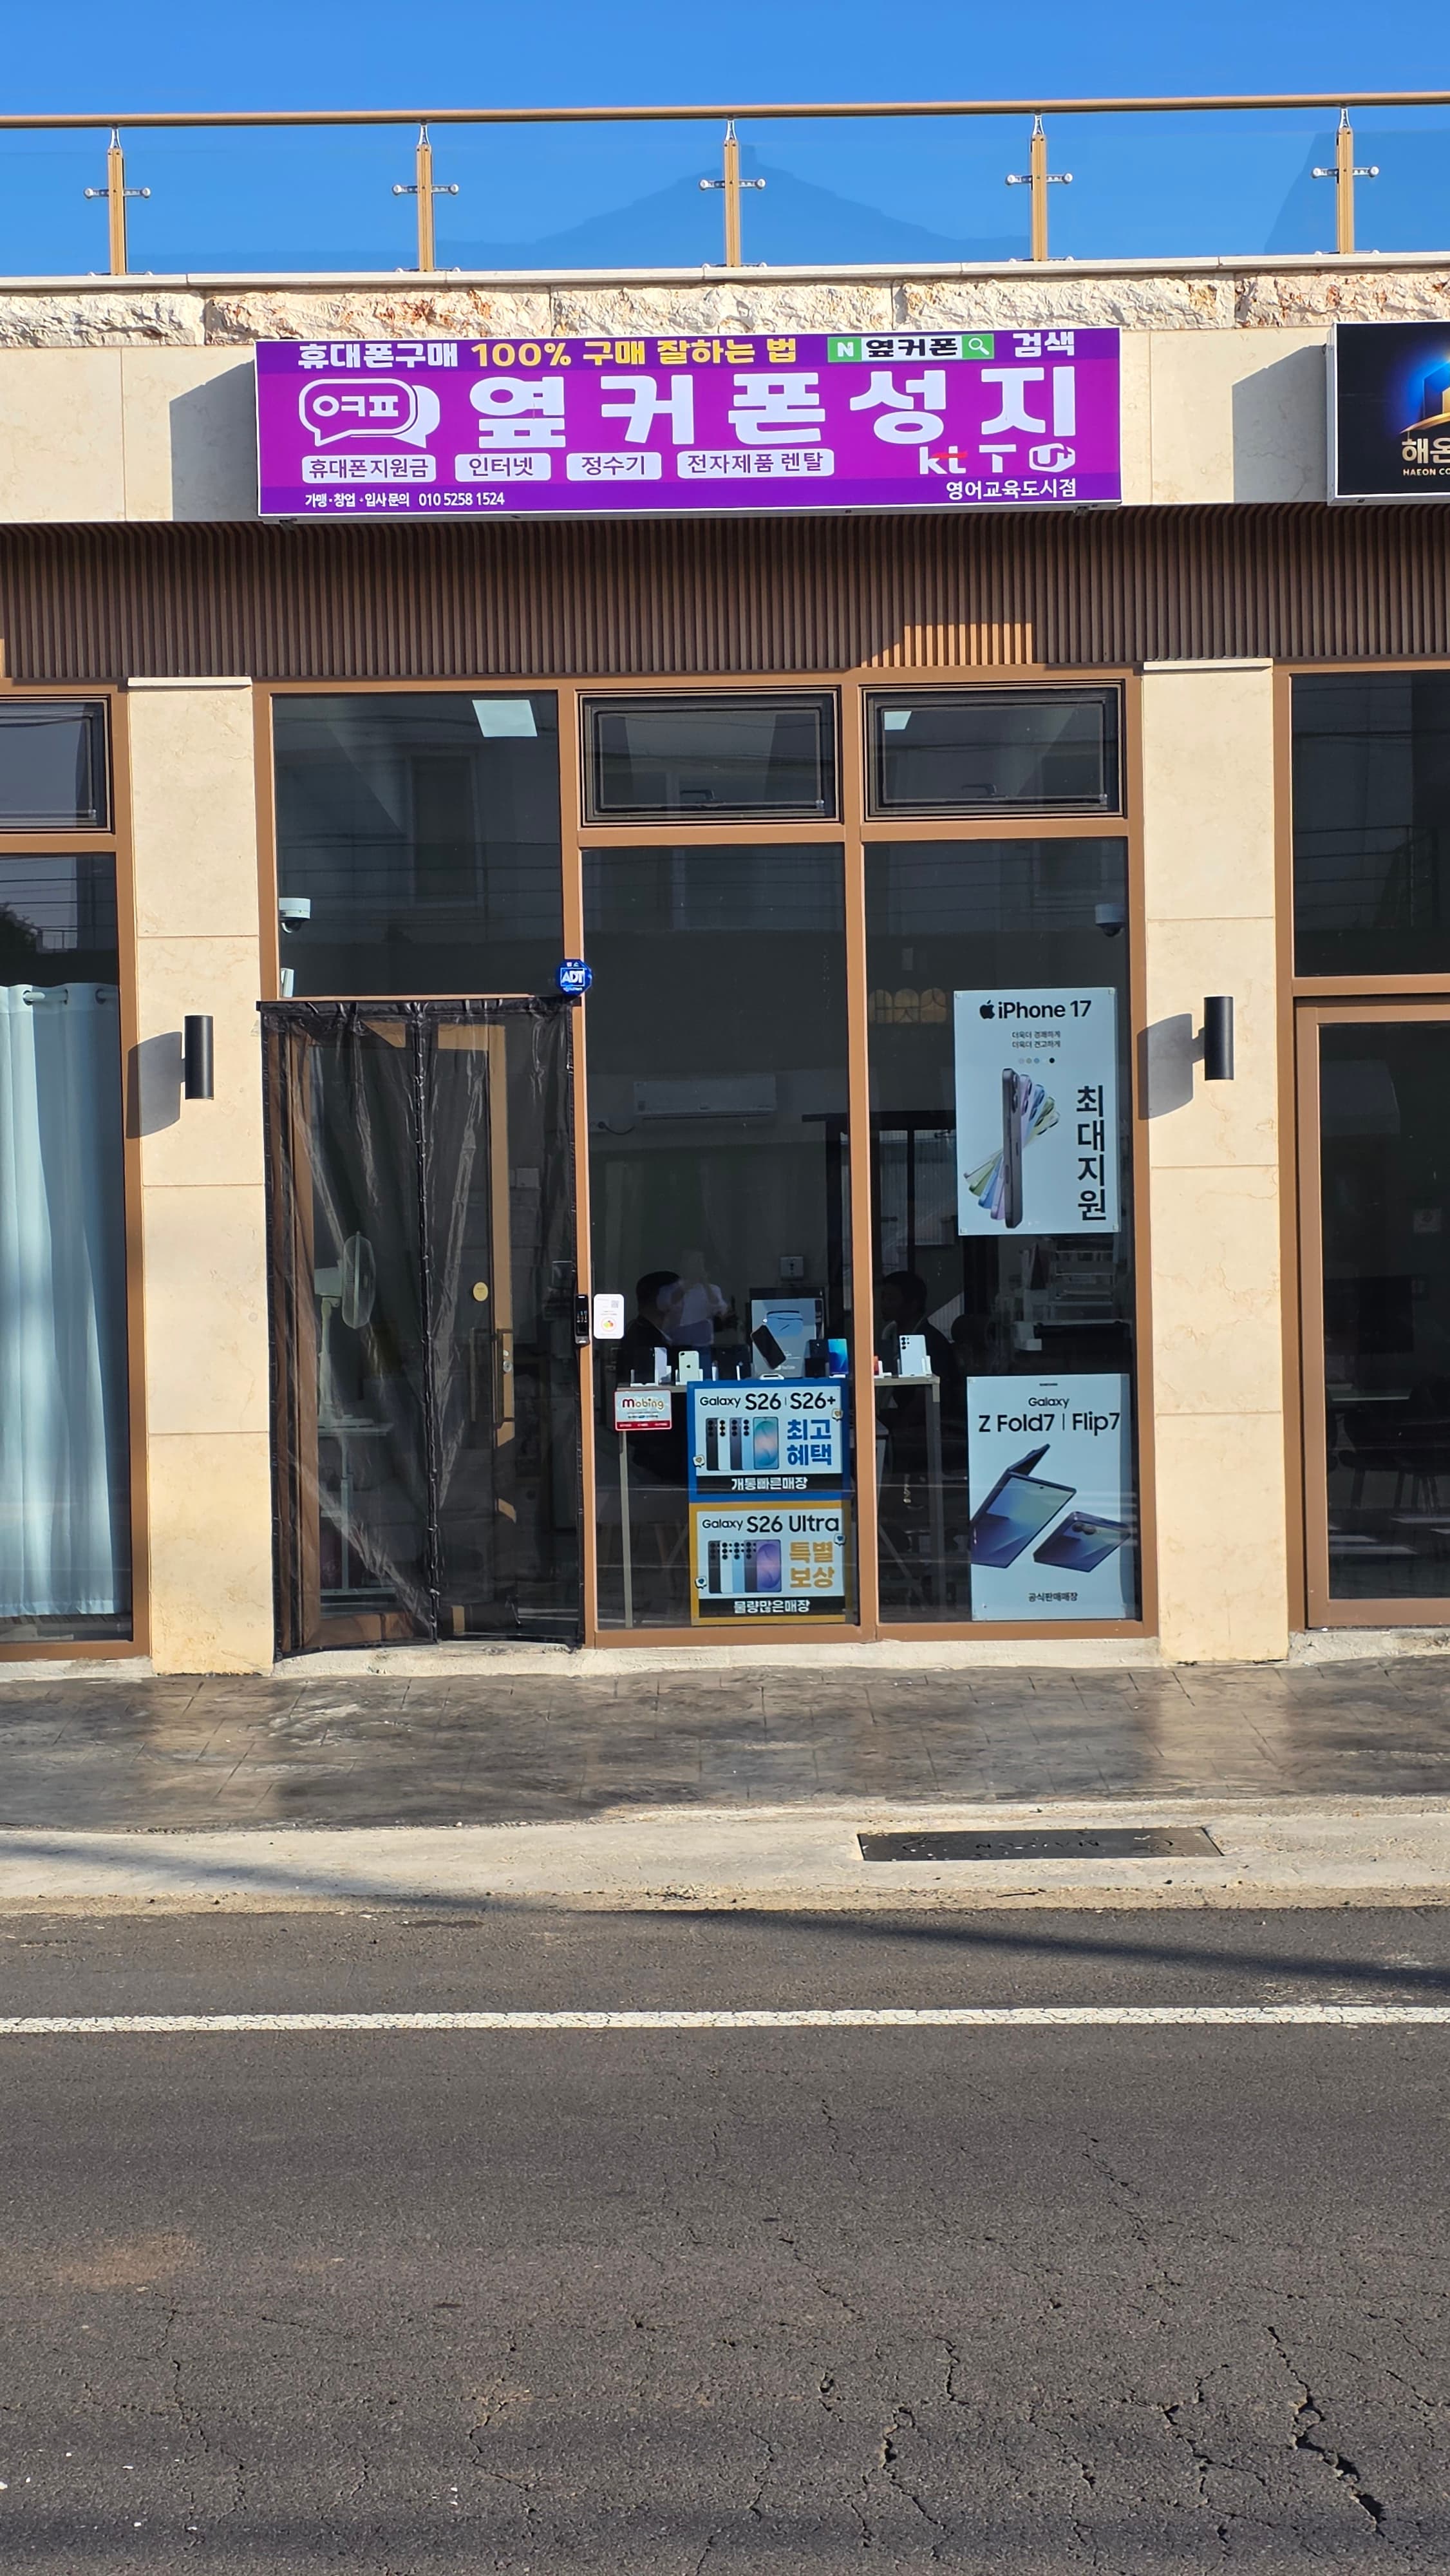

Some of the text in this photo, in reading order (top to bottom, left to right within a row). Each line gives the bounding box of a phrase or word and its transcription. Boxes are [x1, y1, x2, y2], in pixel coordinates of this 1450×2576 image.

[298, 337, 796, 369] 휴대폰구매 100% 구매 잘하는 법
[837, 341, 854, 357] N
[866, 337, 958, 358] 옆커폰
[1013, 331, 1075, 357] 검색
[309, 458, 429, 478] 휴대폰지원금
[469, 457, 534, 477] 인터넷
[581, 455, 646, 476] 정수기
[687, 451, 824, 474] 전자제품 렌탈
[919, 446, 968, 475] kt
[979, 444, 1017, 473] T
[419, 492, 442, 506] 010
[443, 492, 473, 506] 5258
[476, 491, 505, 506] 1524
[946, 478, 1077, 500] 영어교육도시점
[561, 971, 585, 983] ADT
[998, 1000, 1092, 1019] iPhone 17
[1076, 1084, 1107, 1221] 최대지원
[700, 1392, 836, 1410] Galaxy S26 S26+
[1028, 1396, 1069, 1408] Galaxy
[787, 1419, 832, 1441] 최고
[978, 1411, 1120, 1437] Z Fold7 Flip7
[787, 1443, 832, 1466] 혜택
[702, 1515, 840, 1533] Galaxy S26 Ultra
[789, 1541, 834, 1564] 특별
[789, 1567, 835, 1589] 보상
